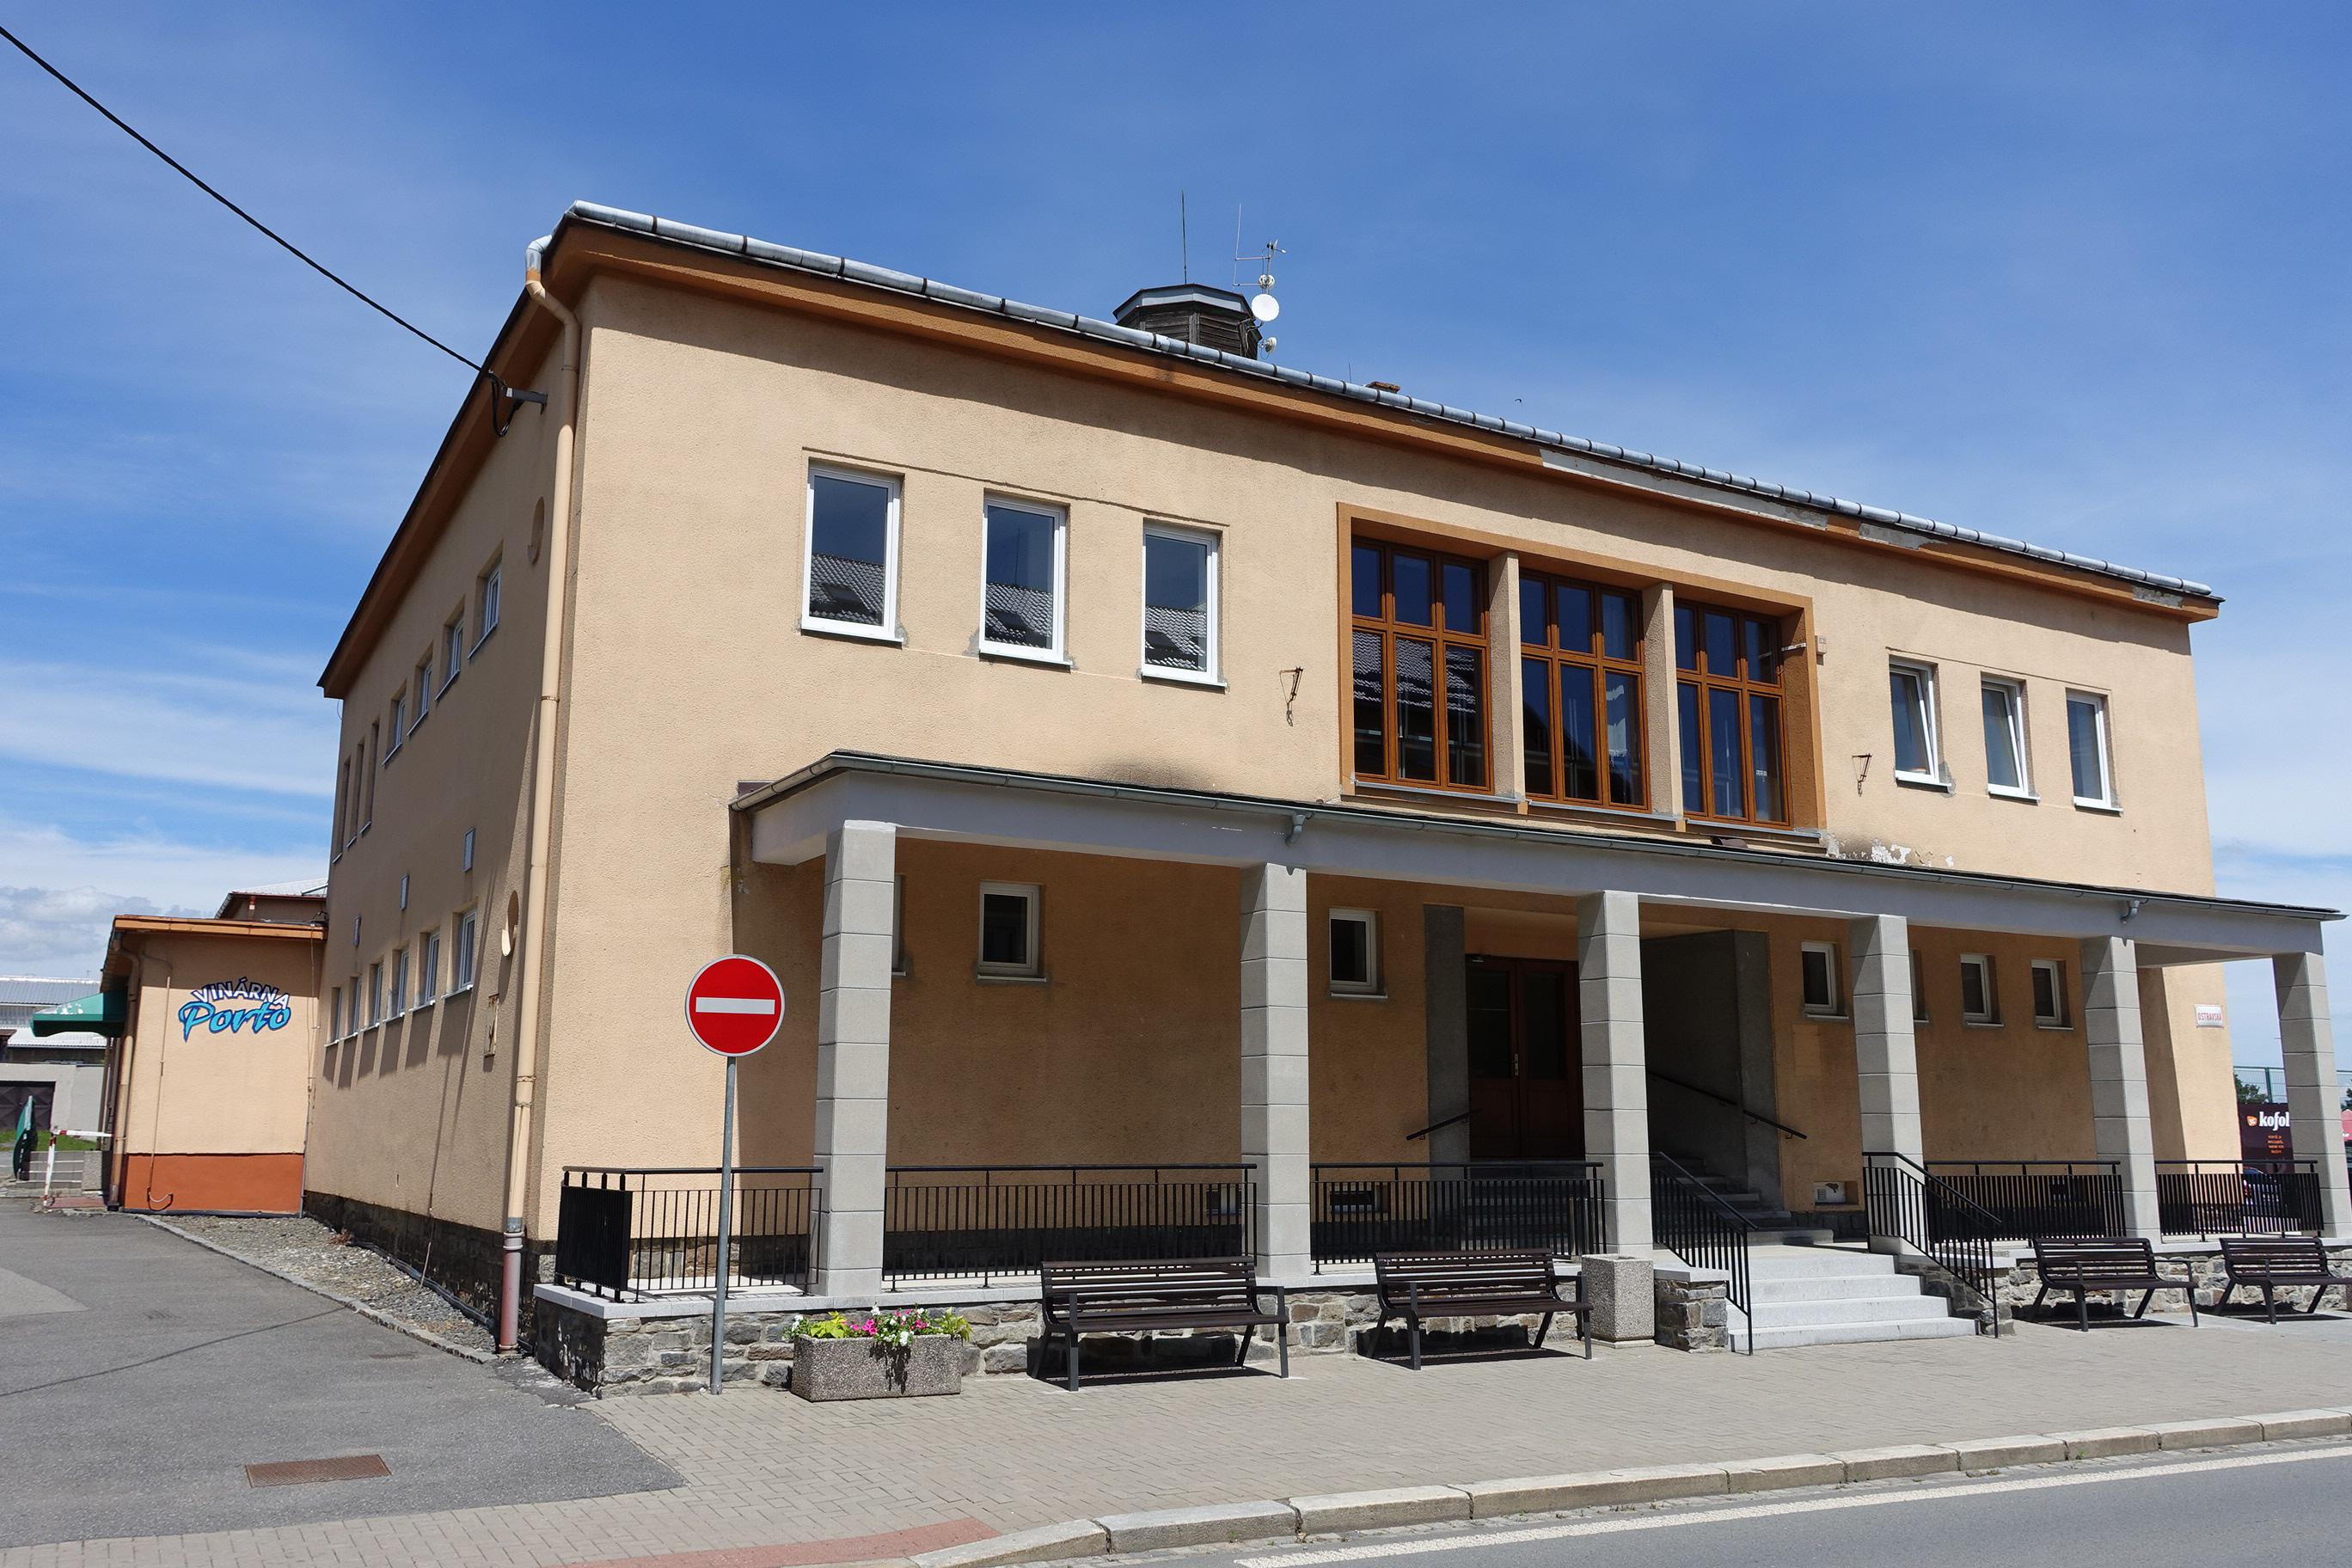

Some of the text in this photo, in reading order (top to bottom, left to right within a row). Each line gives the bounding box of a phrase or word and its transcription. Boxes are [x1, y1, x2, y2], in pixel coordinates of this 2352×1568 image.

[191, 977, 290, 1010] VINÁRNA
[178, 1001, 291, 1043] Porto
[2259, 1112, 2290, 1130] kofol
